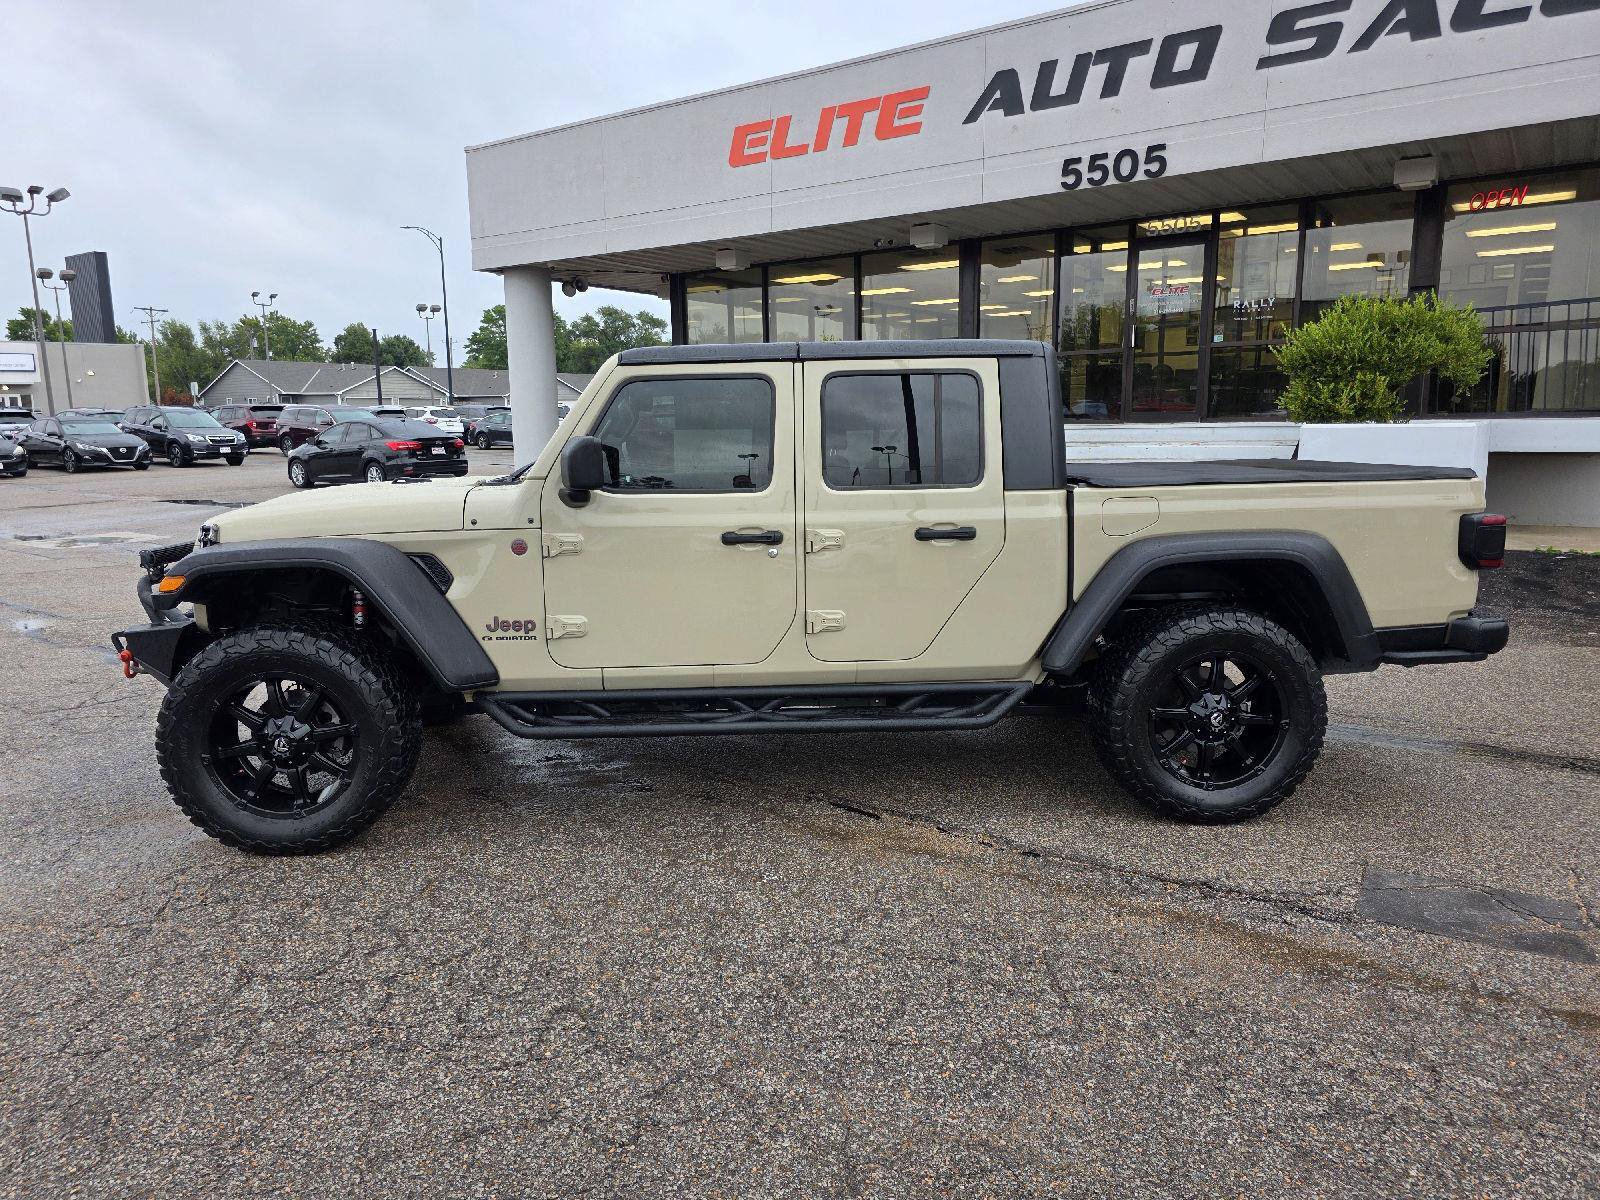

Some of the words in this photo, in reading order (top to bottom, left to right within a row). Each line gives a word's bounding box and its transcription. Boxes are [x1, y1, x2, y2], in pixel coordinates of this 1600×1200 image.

[729, 85, 931, 168] ELITE
[961, 24, 1223, 124] AUTO
[1255, 0, 1600, 70] SAL
[1060, 143, 1168, 190] 5505
[1469, 184, 1529, 211] OPEN
[1146, 216, 1201, 236] 5505
[1151, 285, 1190, 296] ELITE
[1233, 297, 1276, 309] RALLY
[485, 615, 537, 634] Jeep
